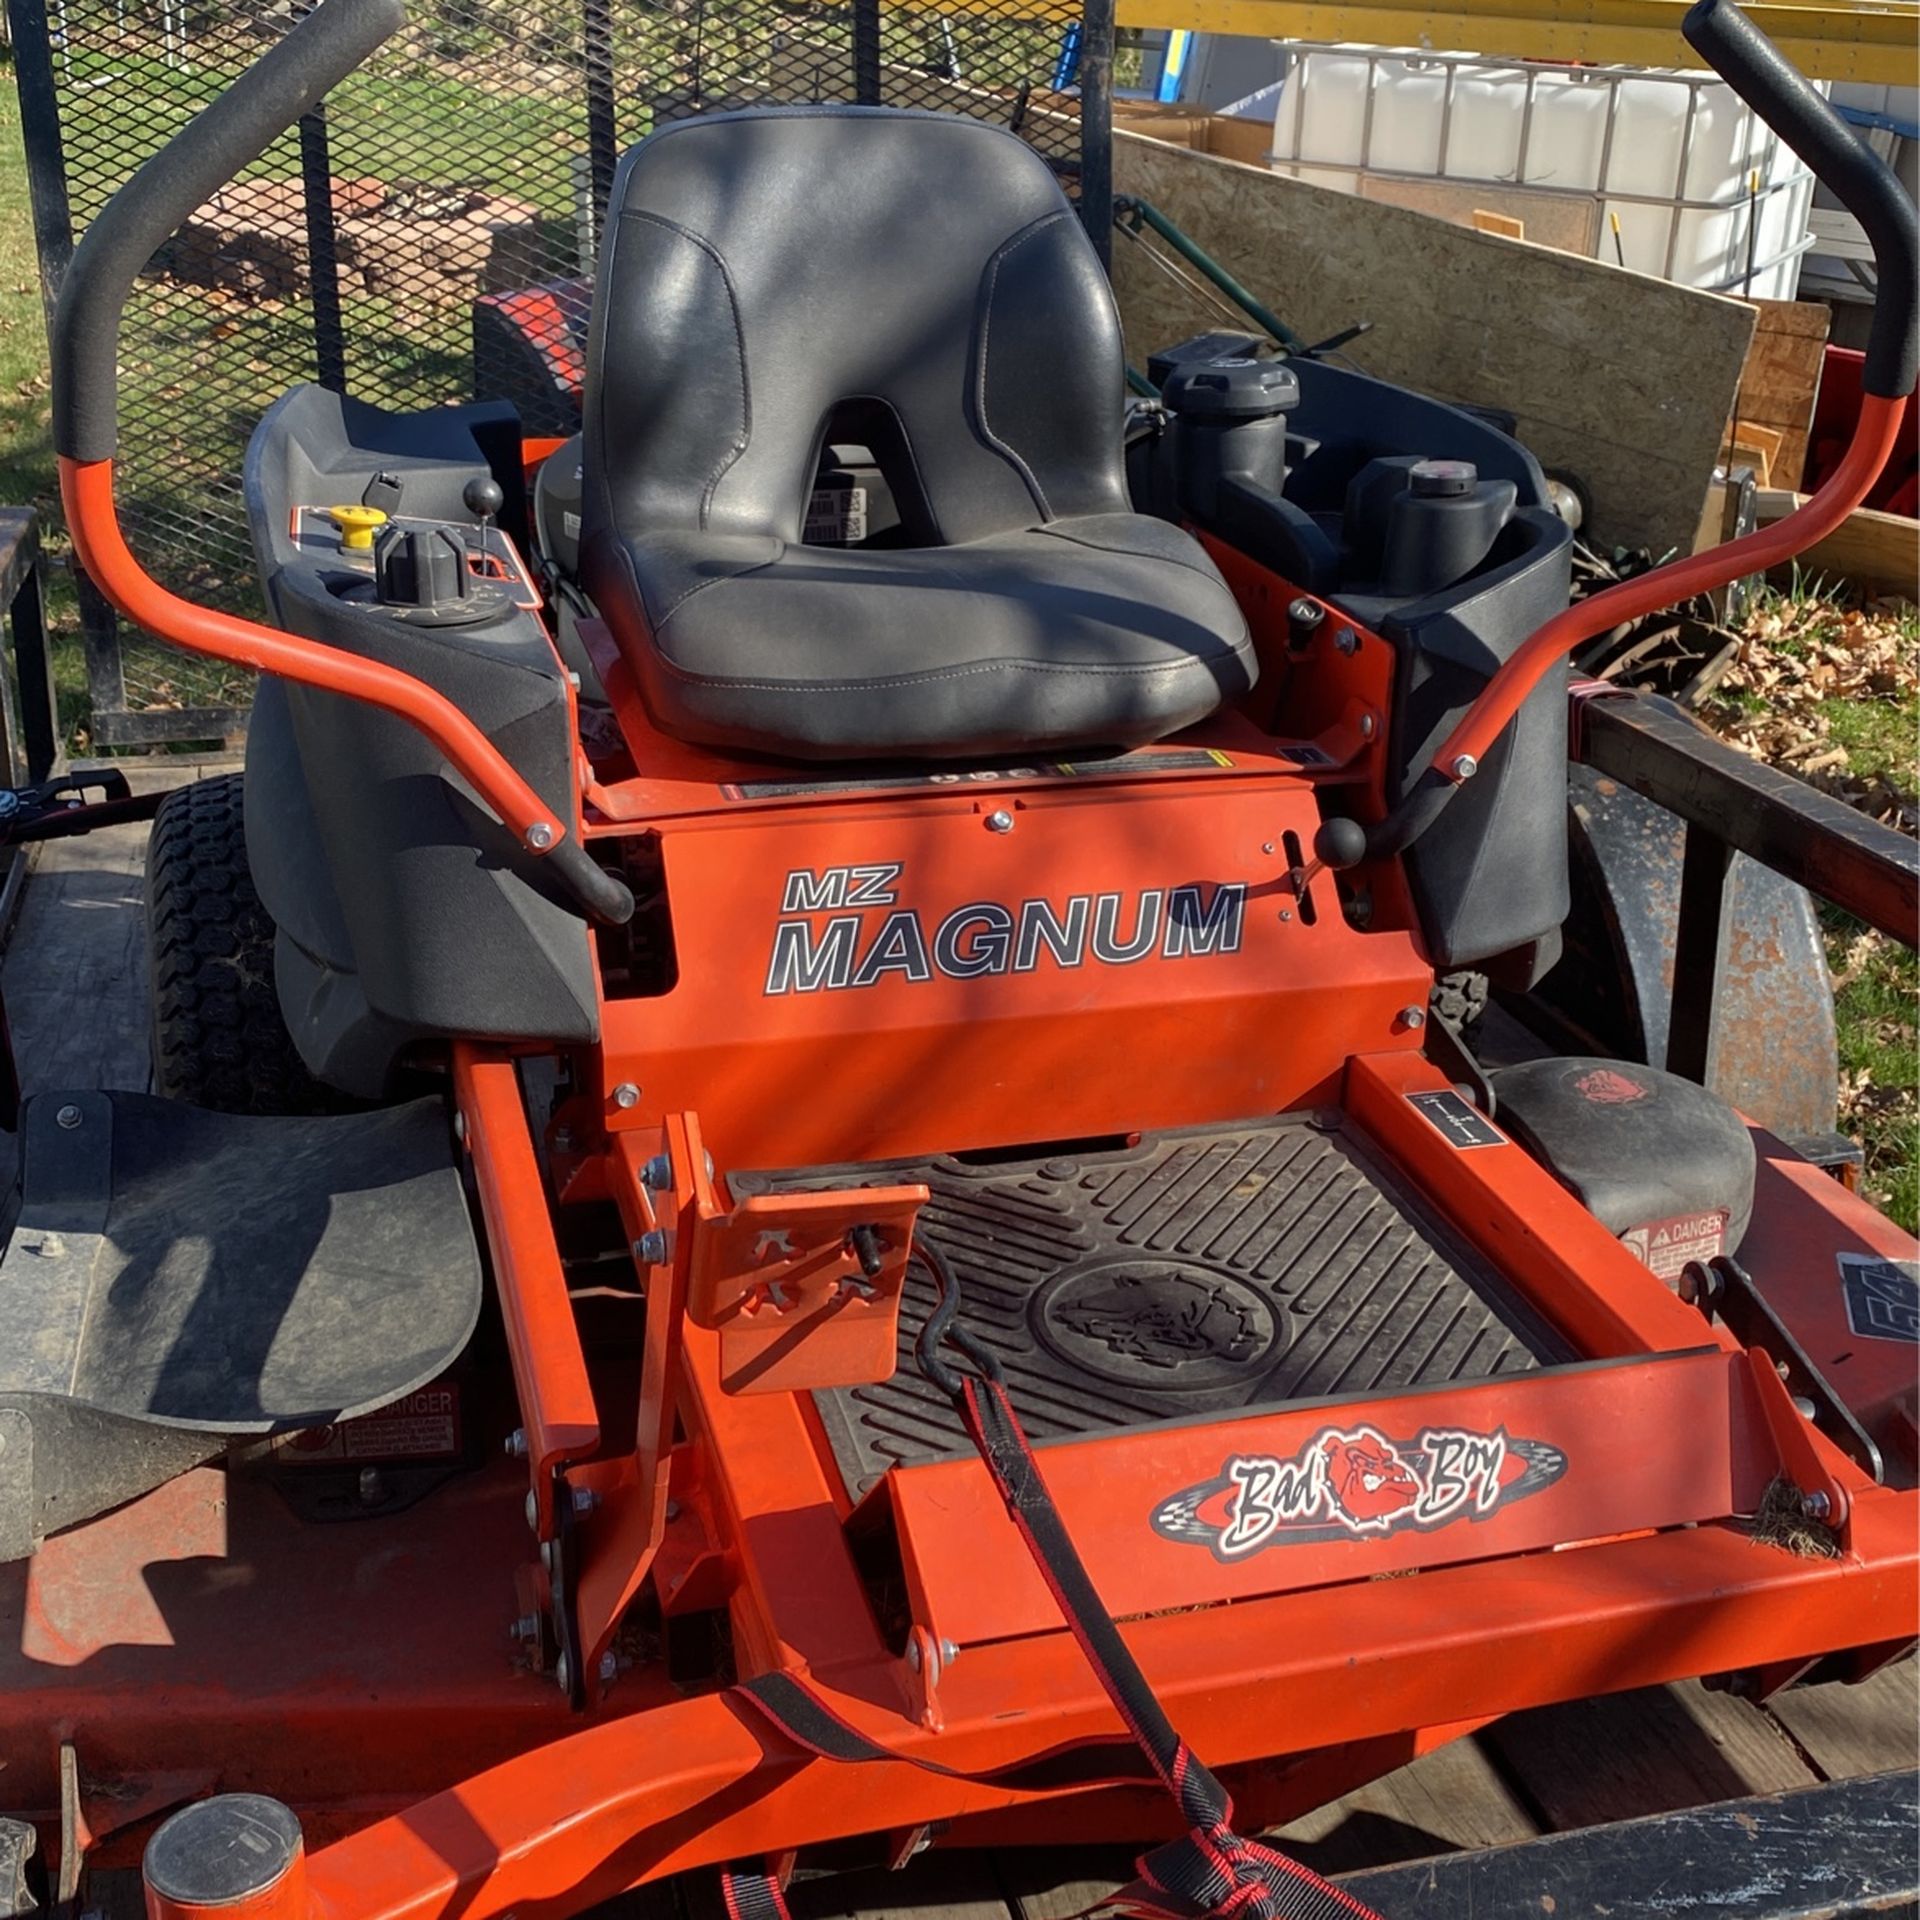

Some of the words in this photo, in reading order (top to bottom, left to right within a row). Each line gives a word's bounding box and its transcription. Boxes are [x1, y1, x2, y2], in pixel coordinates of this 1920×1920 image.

[780, 860, 904, 912] MZ
[763, 883, 1248, 996] MAGNUM
[1672, 1213, 1723, 1242] DANGER
[1217, 1446, 1321, 1554] Bad
[1416, 1429, 1506, 1523] Boy
